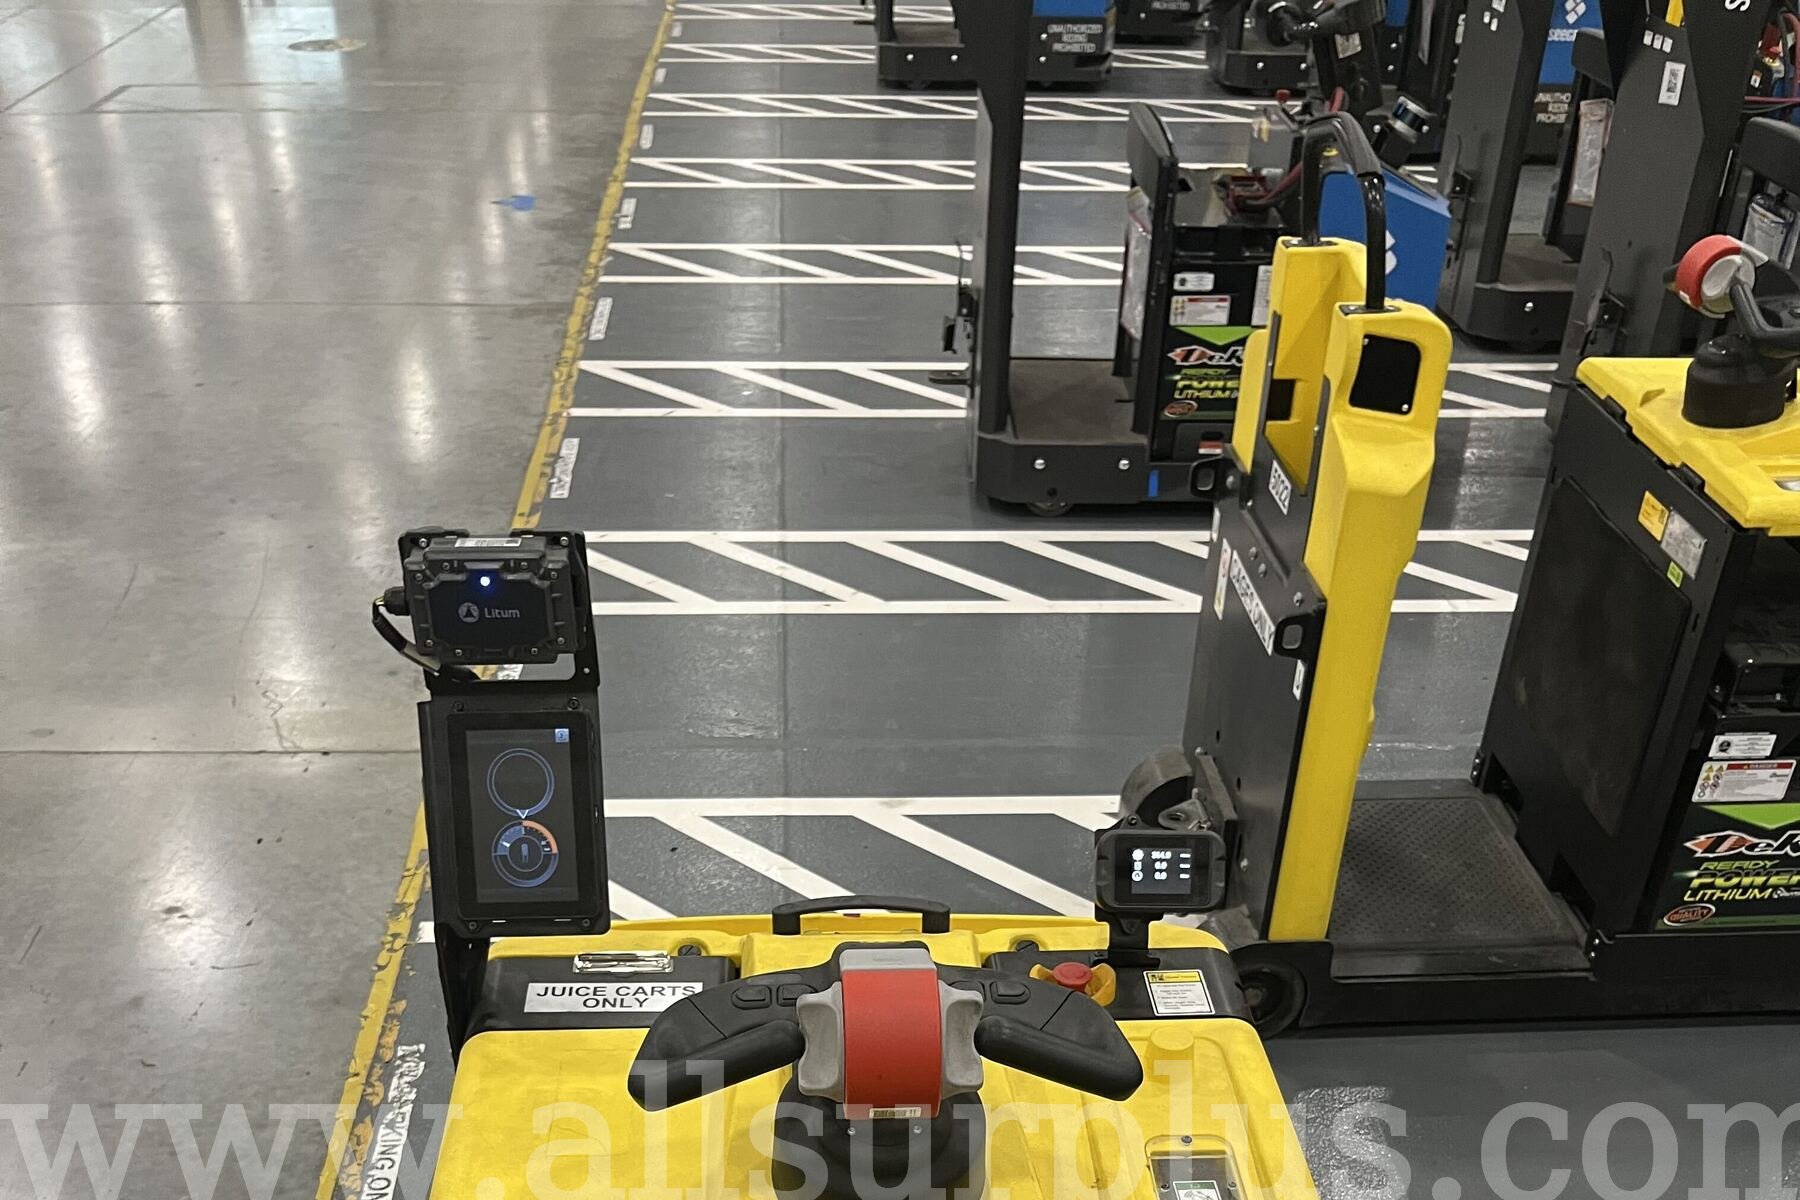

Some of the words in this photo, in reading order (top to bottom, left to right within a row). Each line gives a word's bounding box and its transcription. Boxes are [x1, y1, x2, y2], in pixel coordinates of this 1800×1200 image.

[484, 607, 521, 618] Litum
[1252, 603, 1274, 652] ONLY
[1700, 860, 1780, 870] READY
[1684, 888, 1773, 901] LITHIUM
[536, 986, 608, 998] JUICE
[615, 985, 697, 997] CARTS
[582, 997, 650, 1009] ONLY
